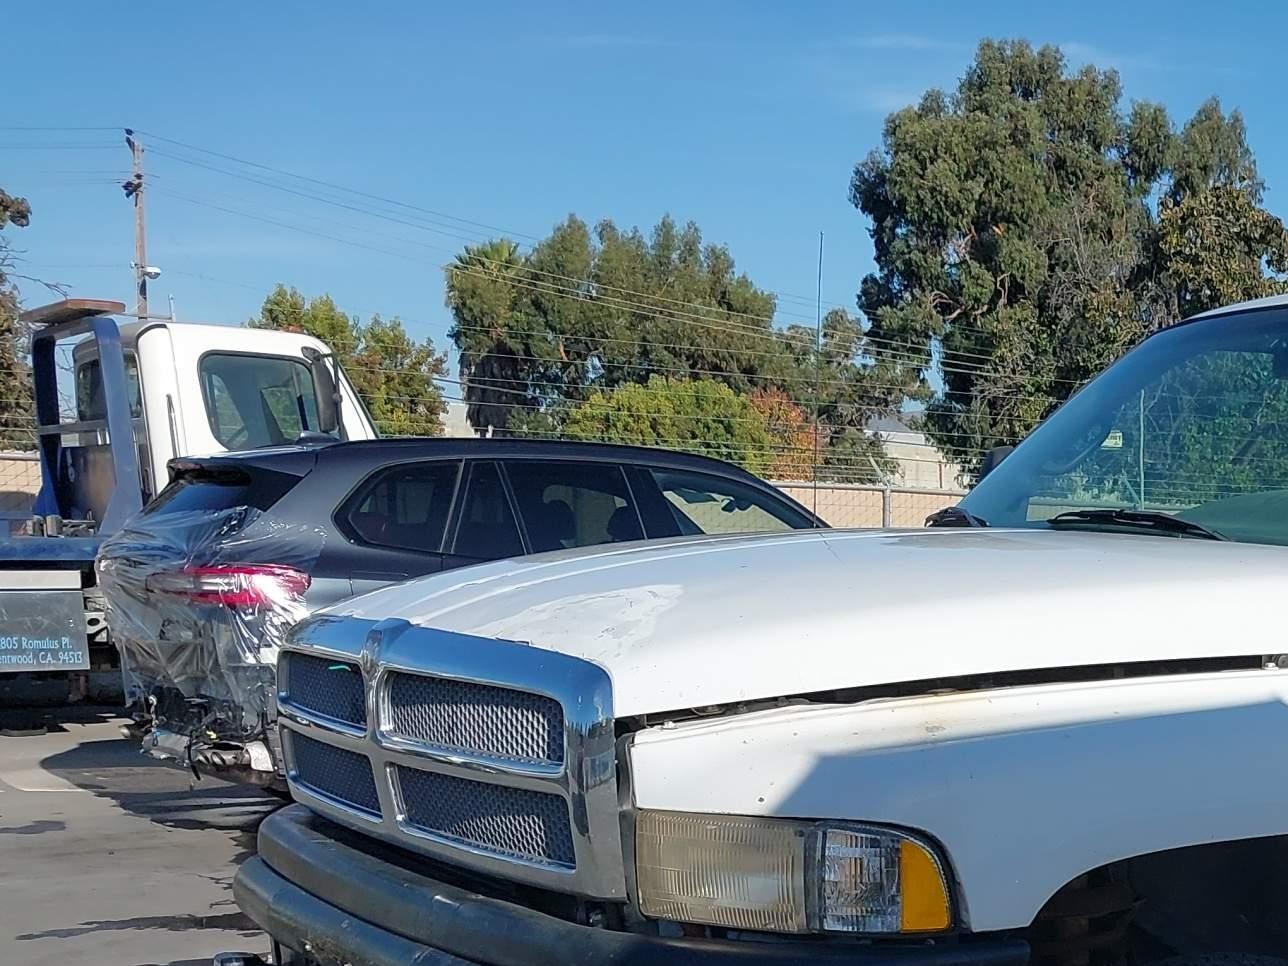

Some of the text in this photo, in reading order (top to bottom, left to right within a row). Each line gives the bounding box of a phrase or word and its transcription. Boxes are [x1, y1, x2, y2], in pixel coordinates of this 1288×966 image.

[0, 636, 18, 650] 805
[21, 636, 60, 650] Romulus
[58, 651, 83, 664] 94513
